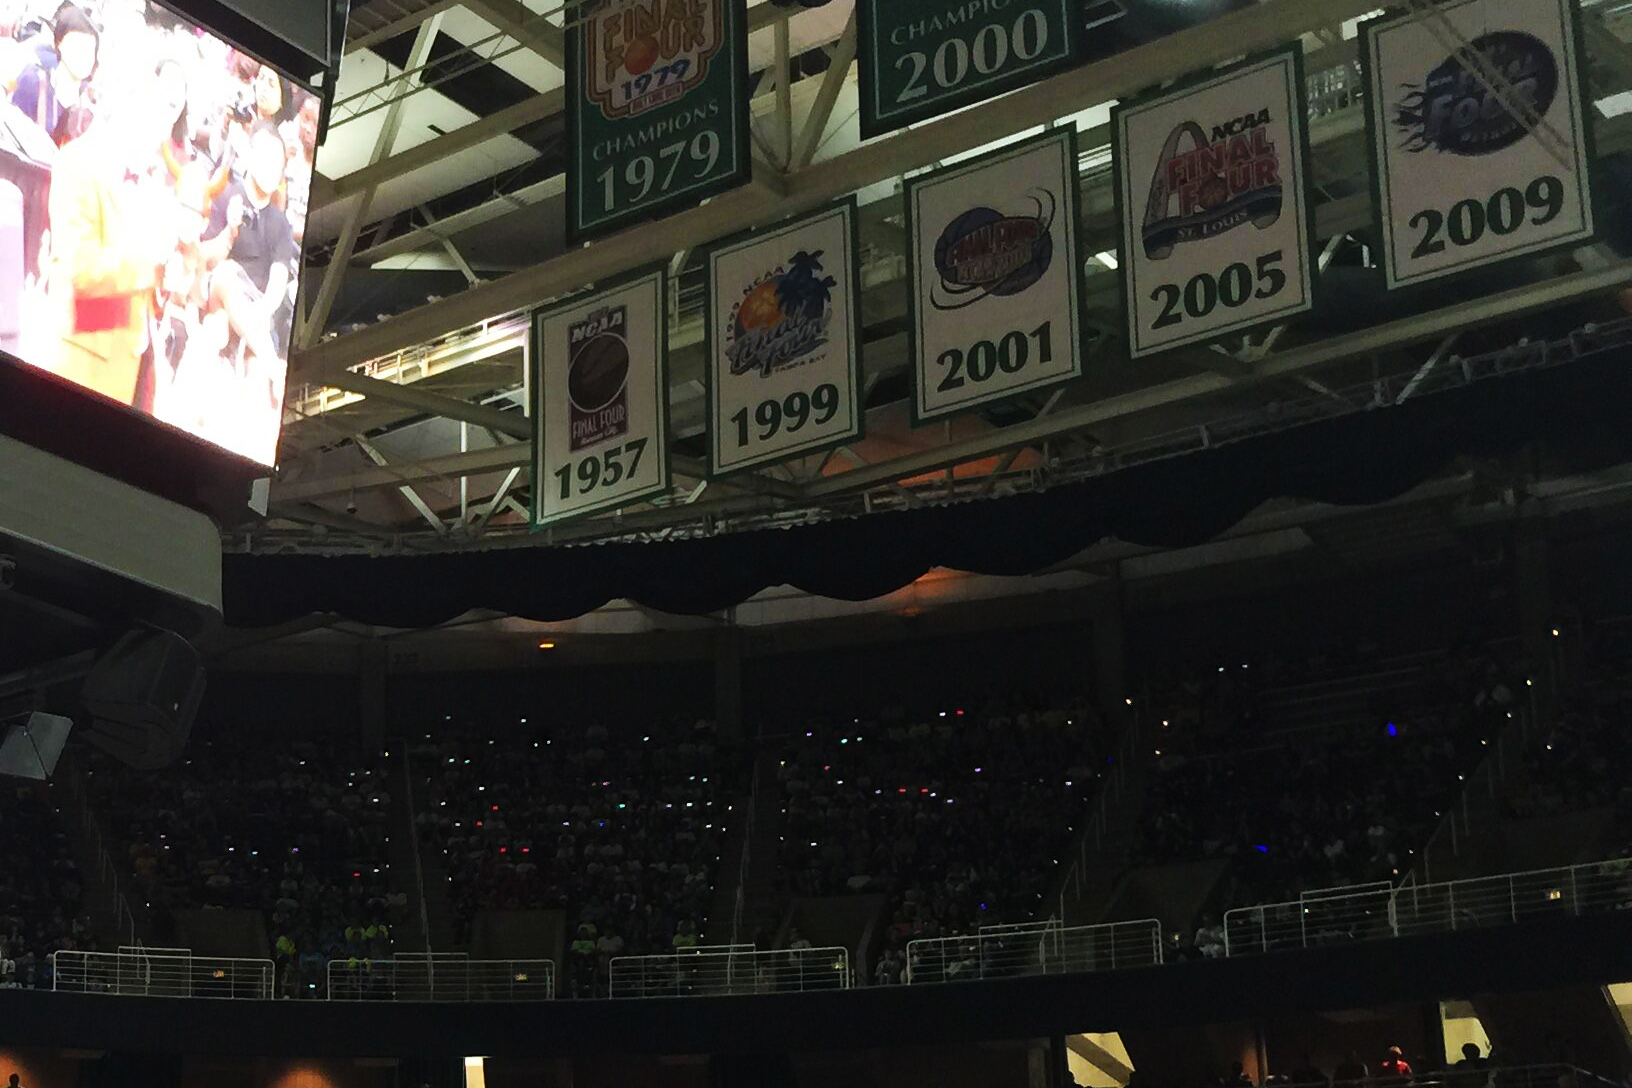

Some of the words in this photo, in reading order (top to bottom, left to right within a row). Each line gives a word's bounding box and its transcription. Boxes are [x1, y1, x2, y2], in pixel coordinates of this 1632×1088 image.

[621, 59, 691, 100] 1979
[894, 9, 1048, 103] 2000
[593, 100, 719, 161] CHAMPIONS
[1211, 108, 1271, 141] NCAA
[597, 130, 720, 212] 1979
[1167, 127, 1275, 191] FINAL
[1408, 175, 1564, 260] 2009
[1150, 250, 1286, 330] 2005
[936, 321, 1052, 392] 2001
[572, 414, 597, 439] FINAL
[599, 403, 625, 428] FOUR
[730, 383, 839, 447] 1999
[554, 437, 648, 500] 1957
